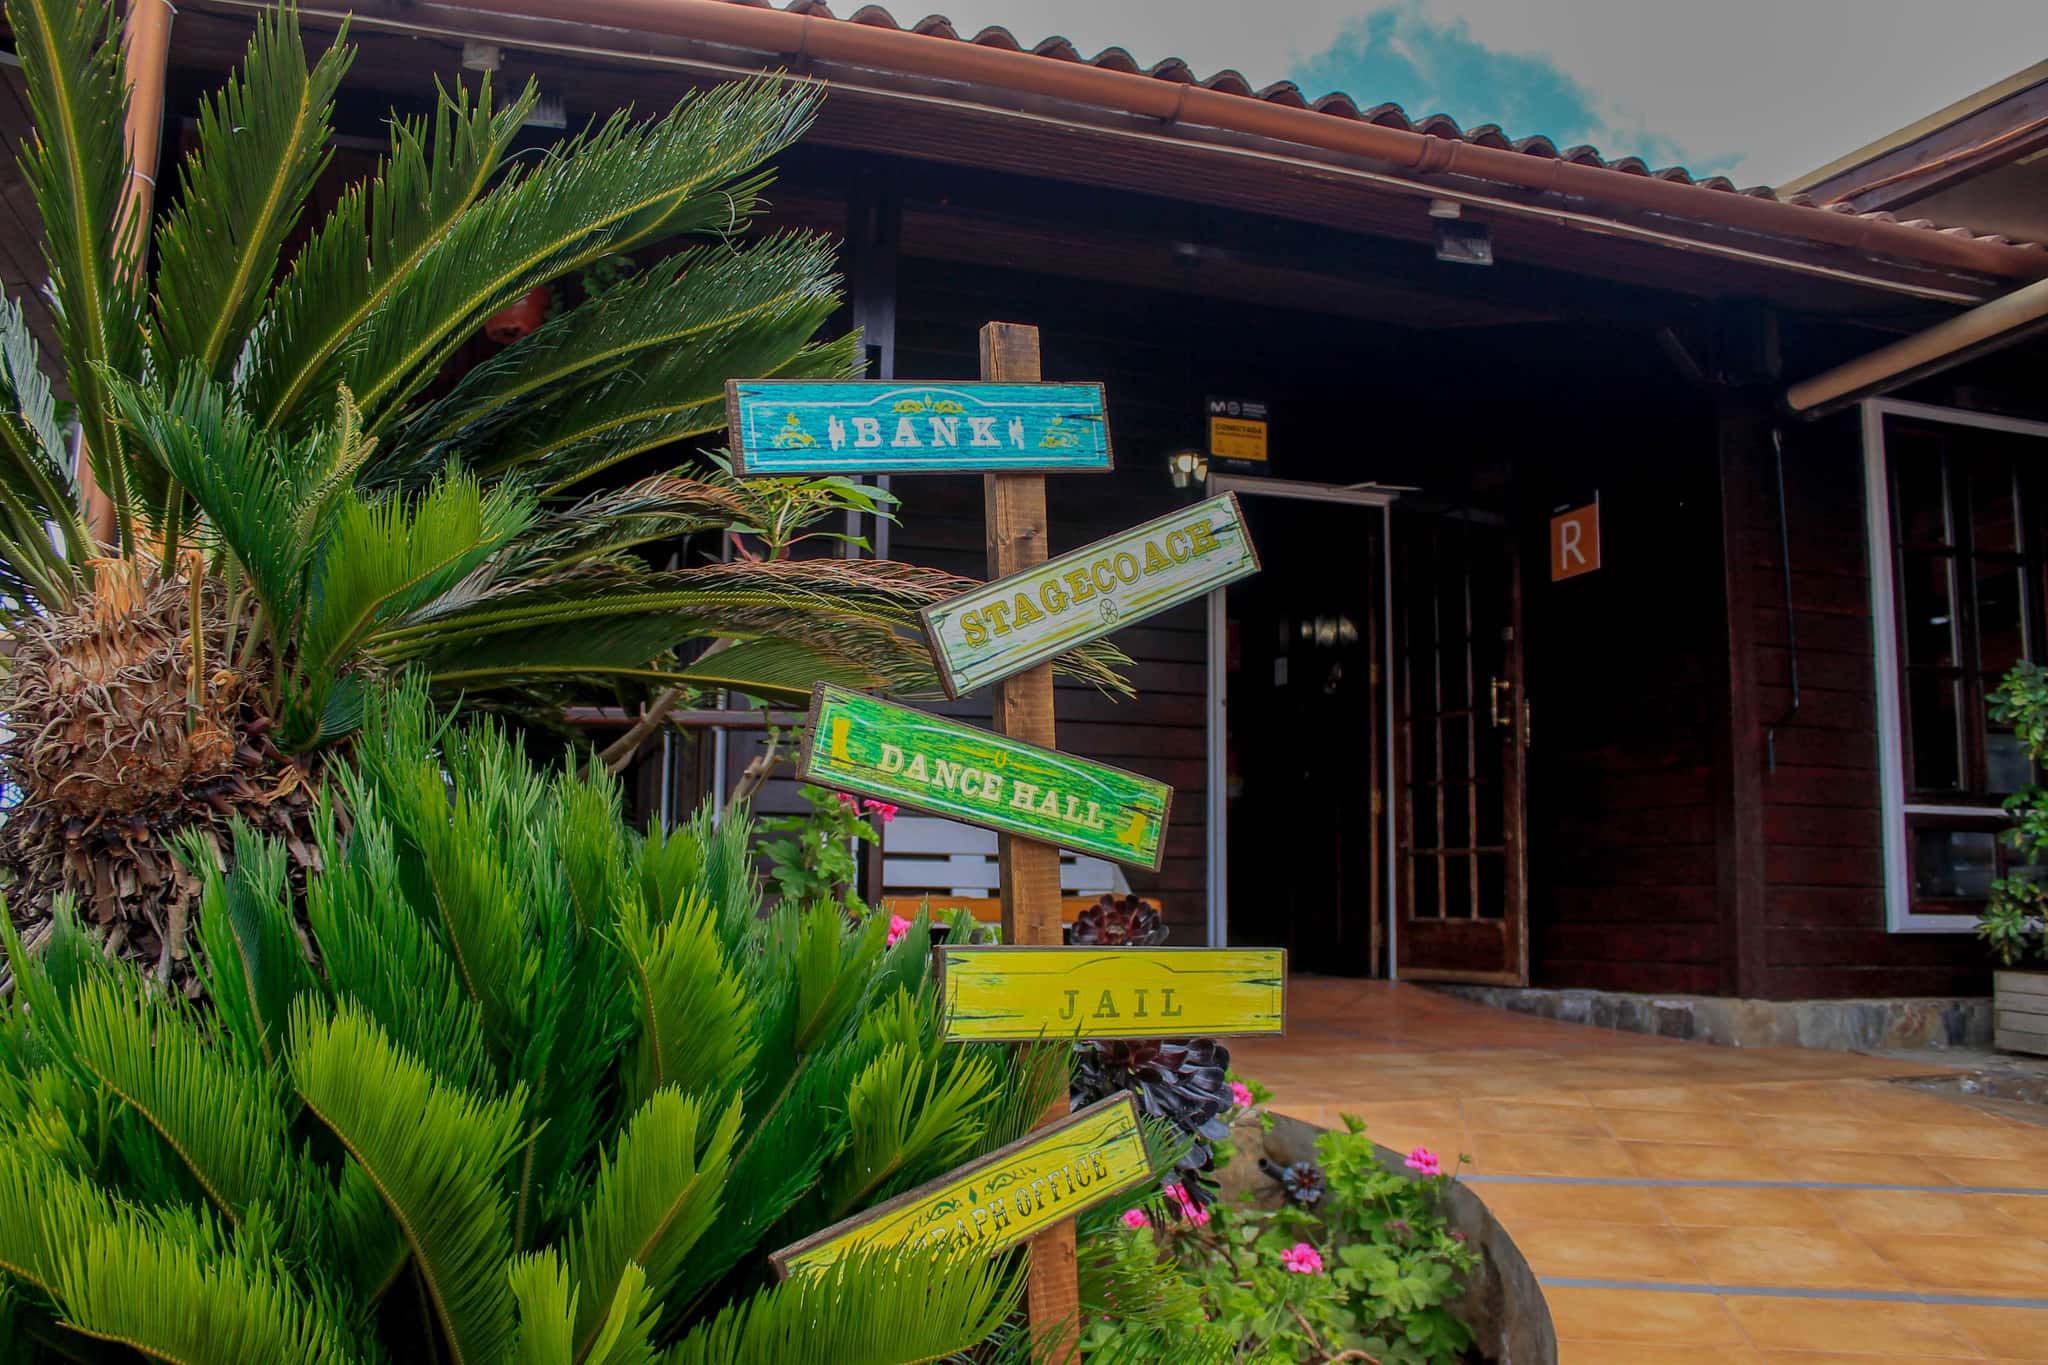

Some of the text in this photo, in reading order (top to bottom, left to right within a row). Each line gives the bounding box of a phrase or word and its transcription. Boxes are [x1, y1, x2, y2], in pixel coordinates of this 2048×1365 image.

[852, 415, 1001, 449] BANK
[1561, 519, 1586, 571] R
[959, 518, 1221, 648] STAGECOACH
[879, 743, 1106, 830] DANCE HALL
[1058, 989, 1183, 1020] JAIL
[1015, 1150, 1108, 1217] OFFICE
